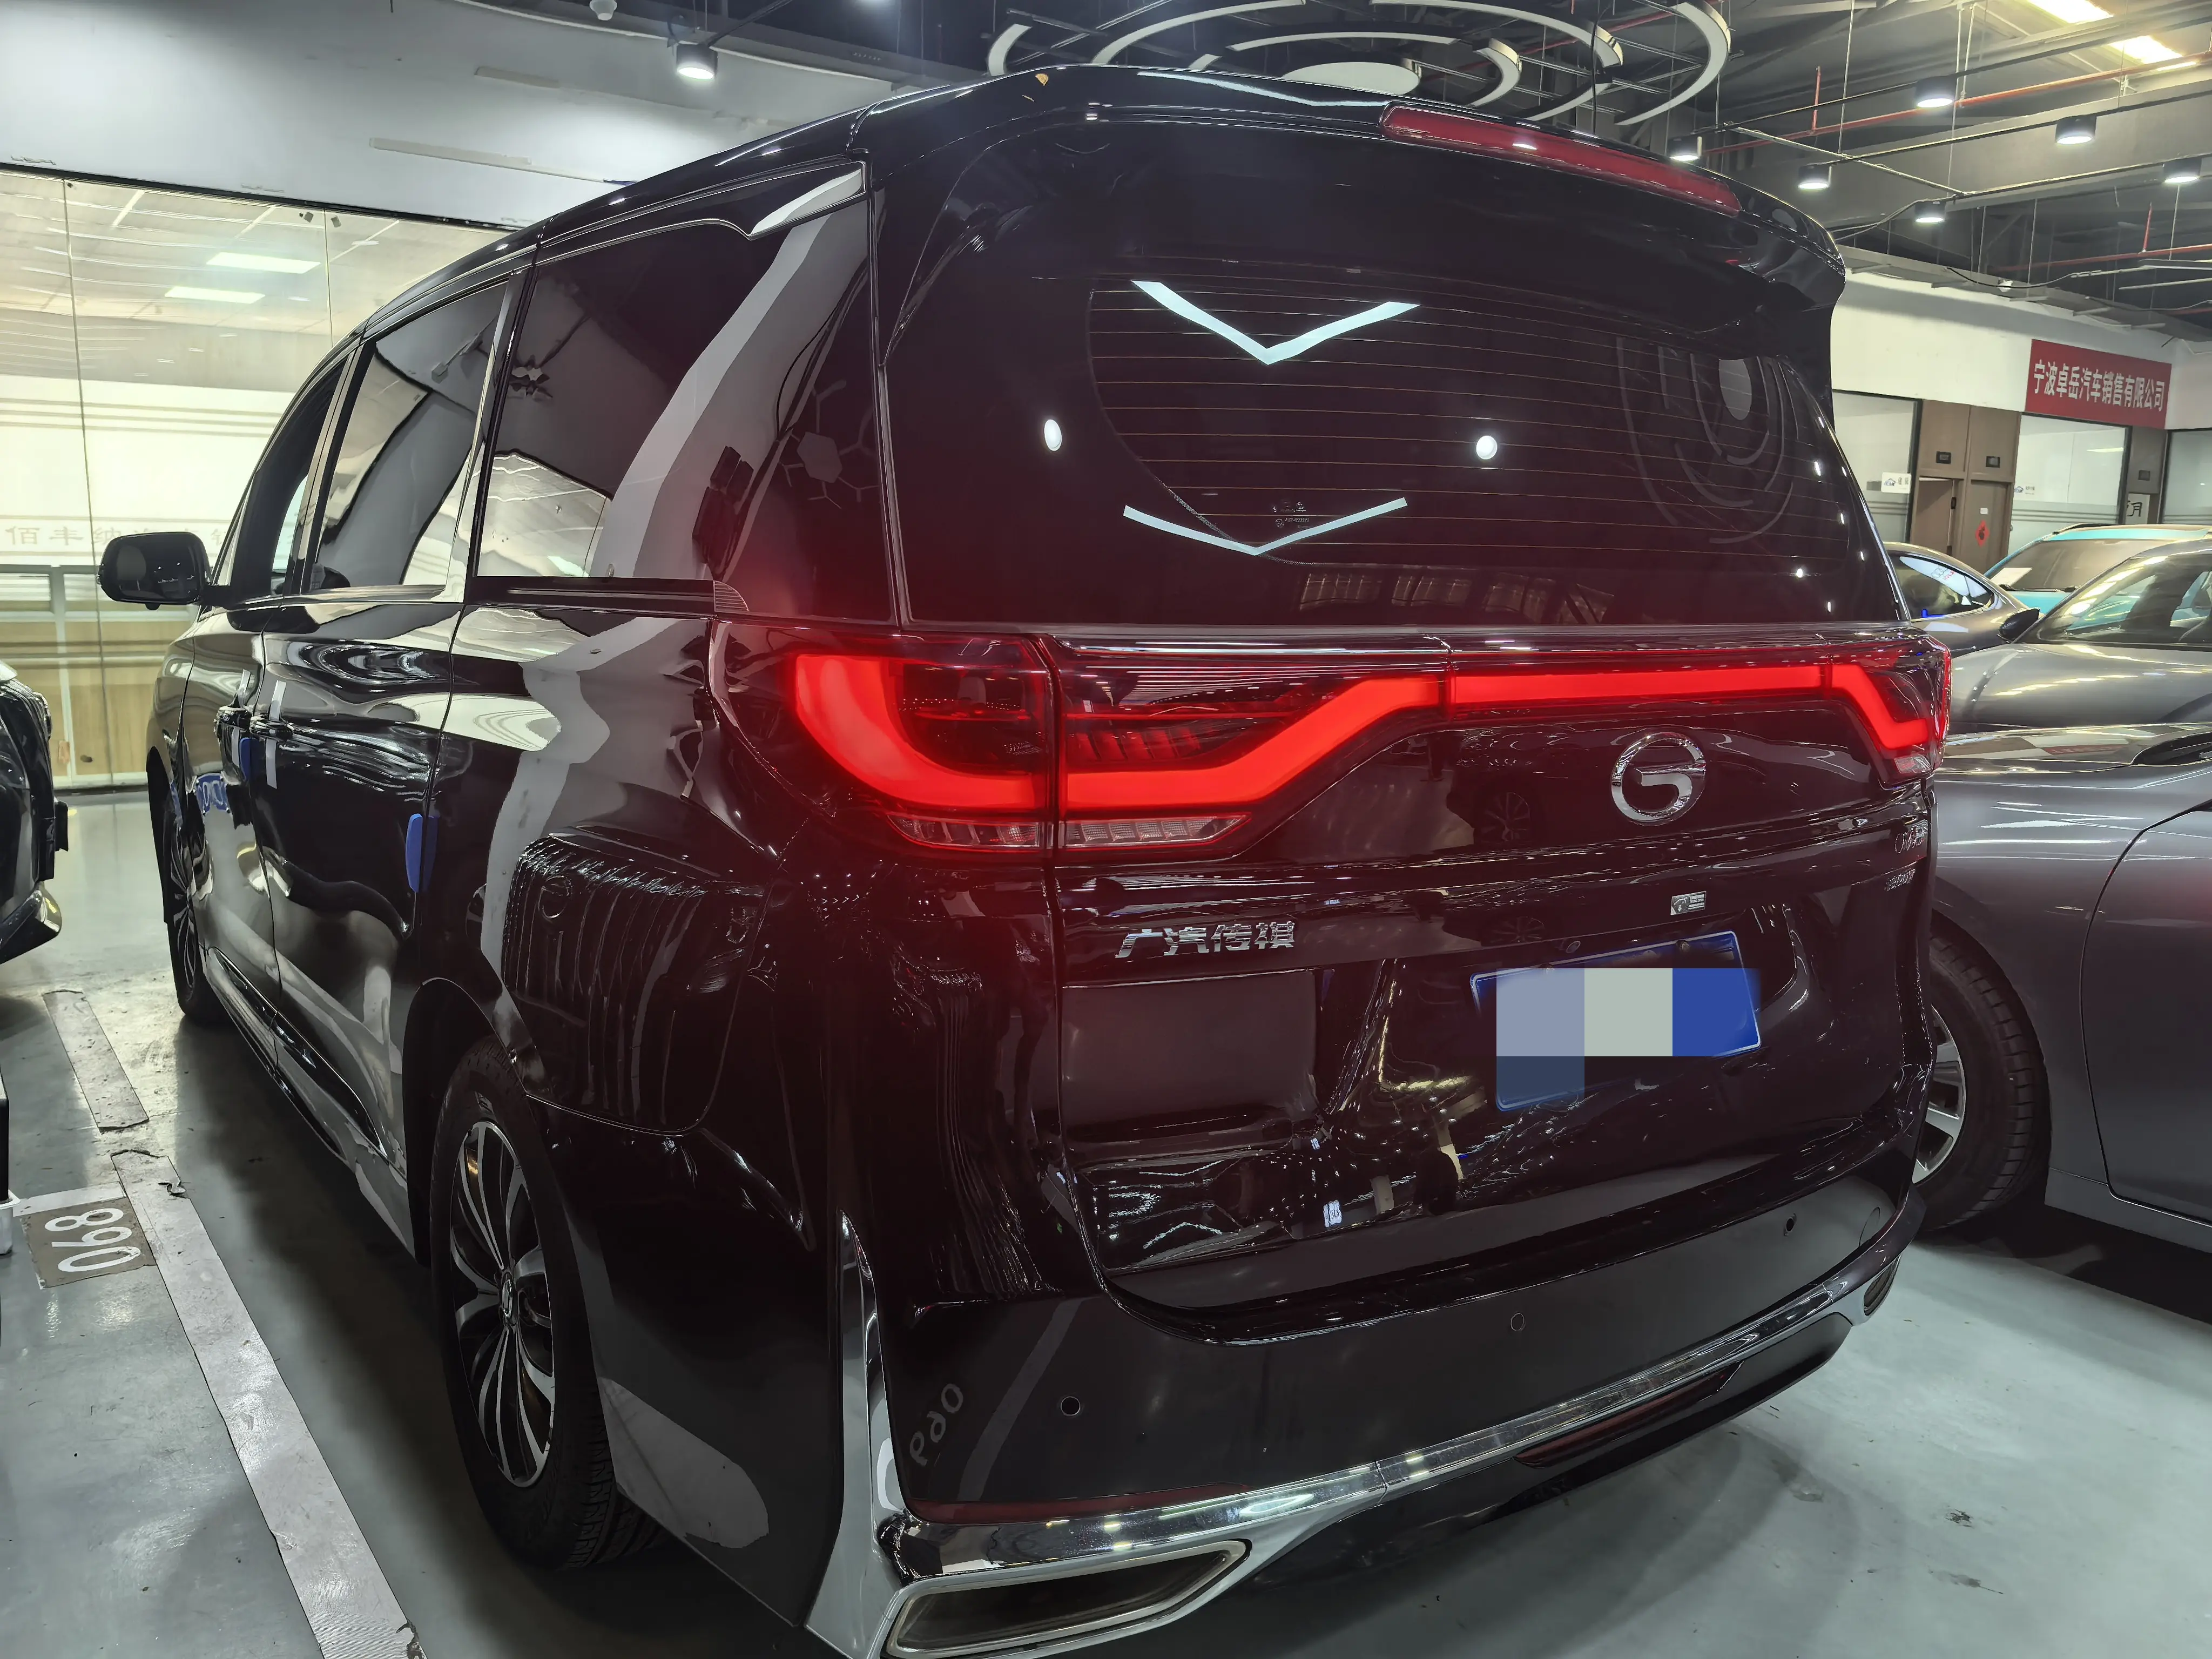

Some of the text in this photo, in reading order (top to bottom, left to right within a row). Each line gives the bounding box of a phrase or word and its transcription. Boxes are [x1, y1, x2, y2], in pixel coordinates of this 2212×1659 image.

[2033, 359, 2165, 412] 宁波卓岳汽车销售有限公司
[1115, 921, 1296, 958] 广汽传祺
[44, 1208, 141, 1272] 068
